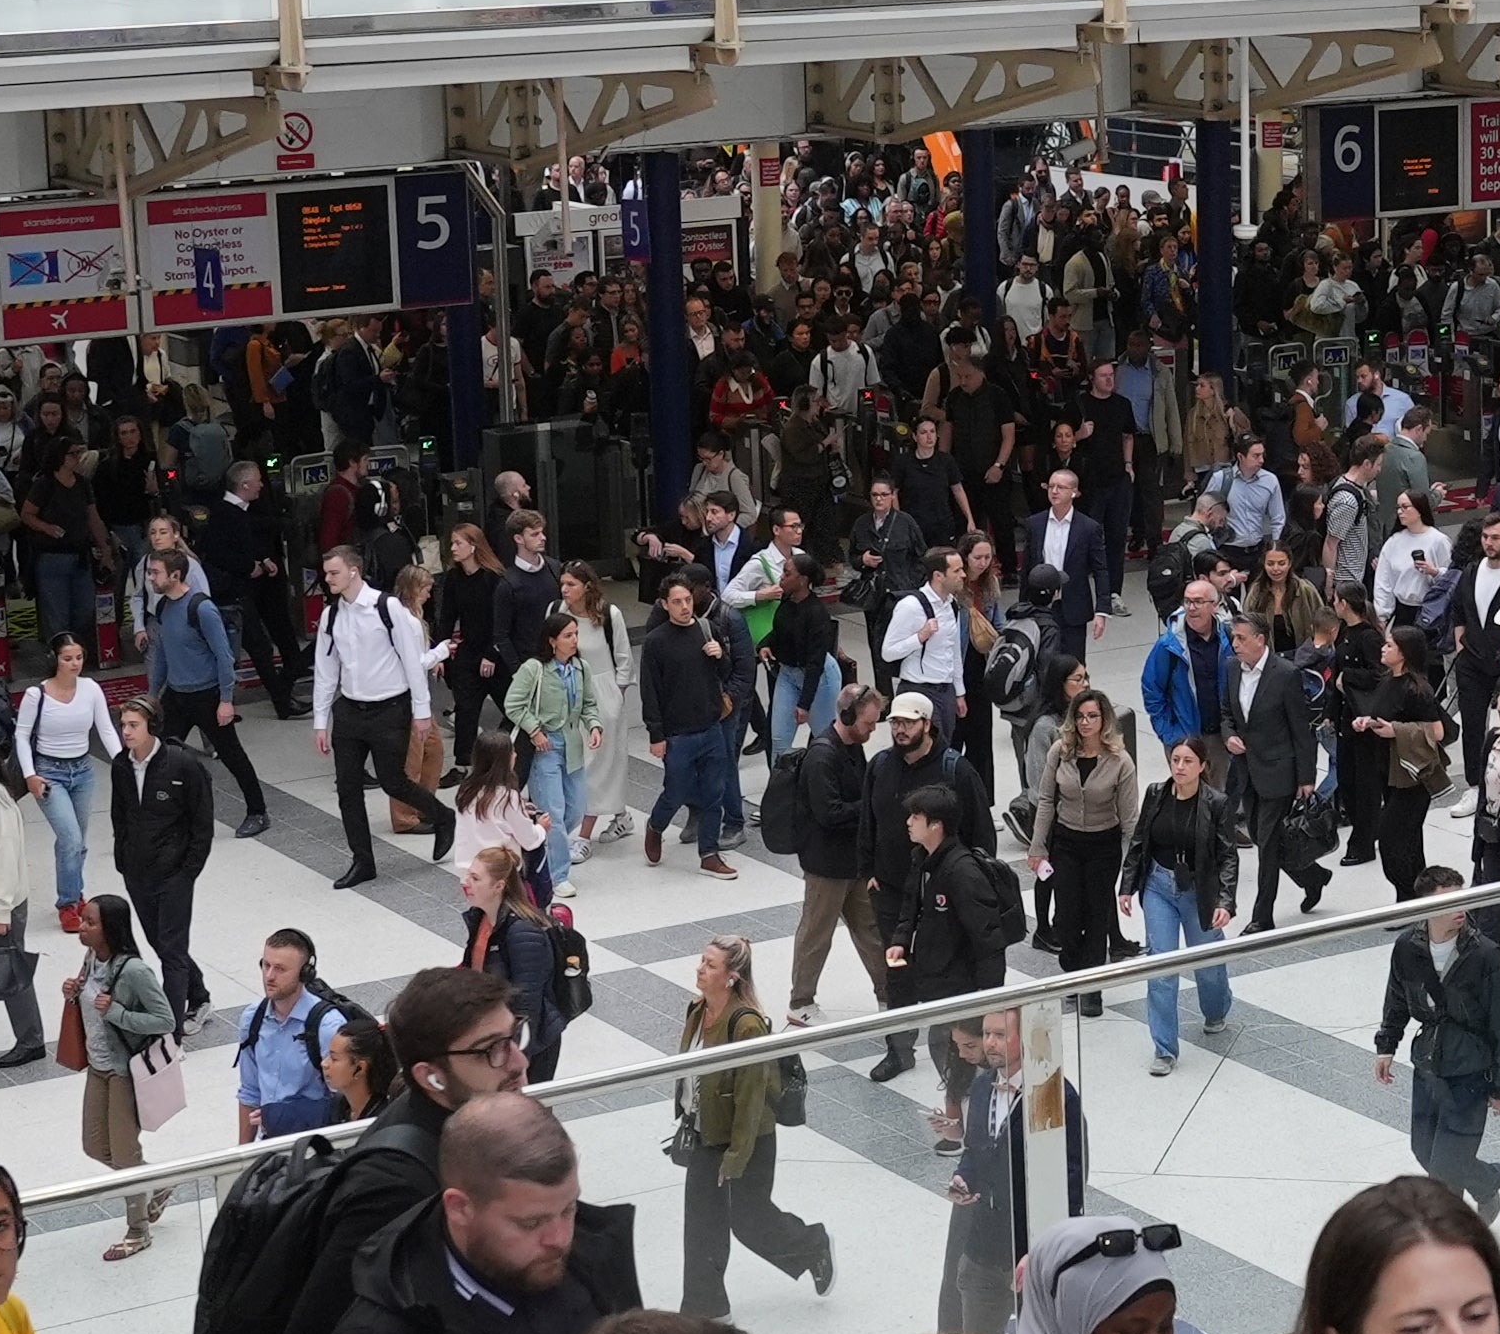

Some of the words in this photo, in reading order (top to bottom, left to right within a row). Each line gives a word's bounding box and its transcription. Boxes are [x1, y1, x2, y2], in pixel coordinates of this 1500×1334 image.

[1480, 131, 1499, 144] will
[1333, 124, 1363, 173] 6
[1480, 147, 1494, 160] 30
[172, 203, 242, 216] stanstedexpress
[23, 214, 95, 228] stanstedexpress
[417, 194, 450, 250] 5
[175, 229, 190, 240] No
[192, 227, 229, 242] Oyster
[231, 226, 244, 236] or
[630, 212, 640, 247] 5
[164, 268, 196, 282] Stans
[202, 260, 216, 299] 4
